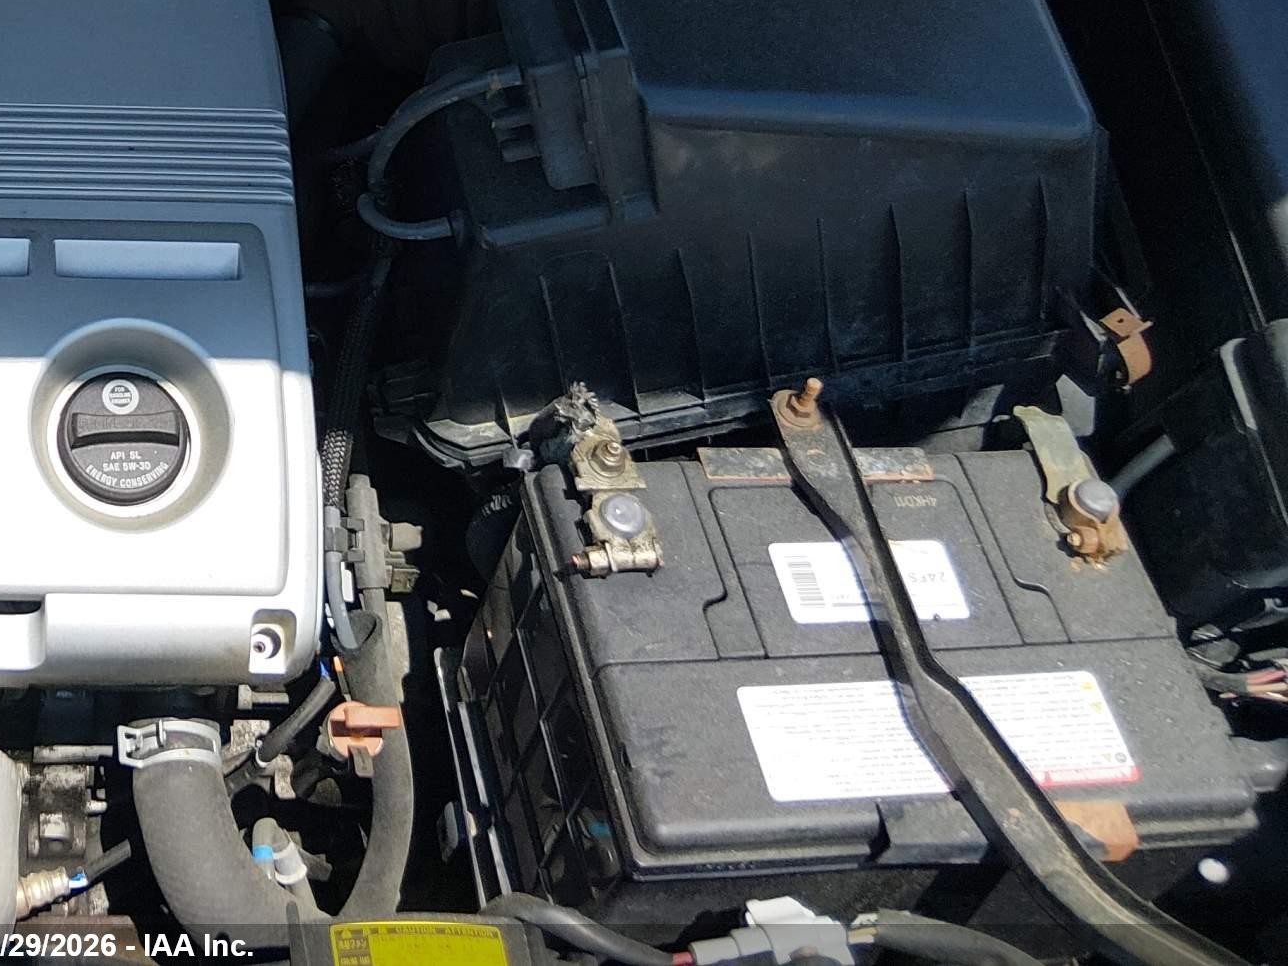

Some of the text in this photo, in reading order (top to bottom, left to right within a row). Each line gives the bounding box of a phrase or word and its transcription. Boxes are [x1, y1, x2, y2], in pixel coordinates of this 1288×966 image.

[110, 450, 142, 460] API SL
[102, 461, 152, 472] SAE 5W-30
[85, 461, 169, 488] ENERGY CONSERVING
